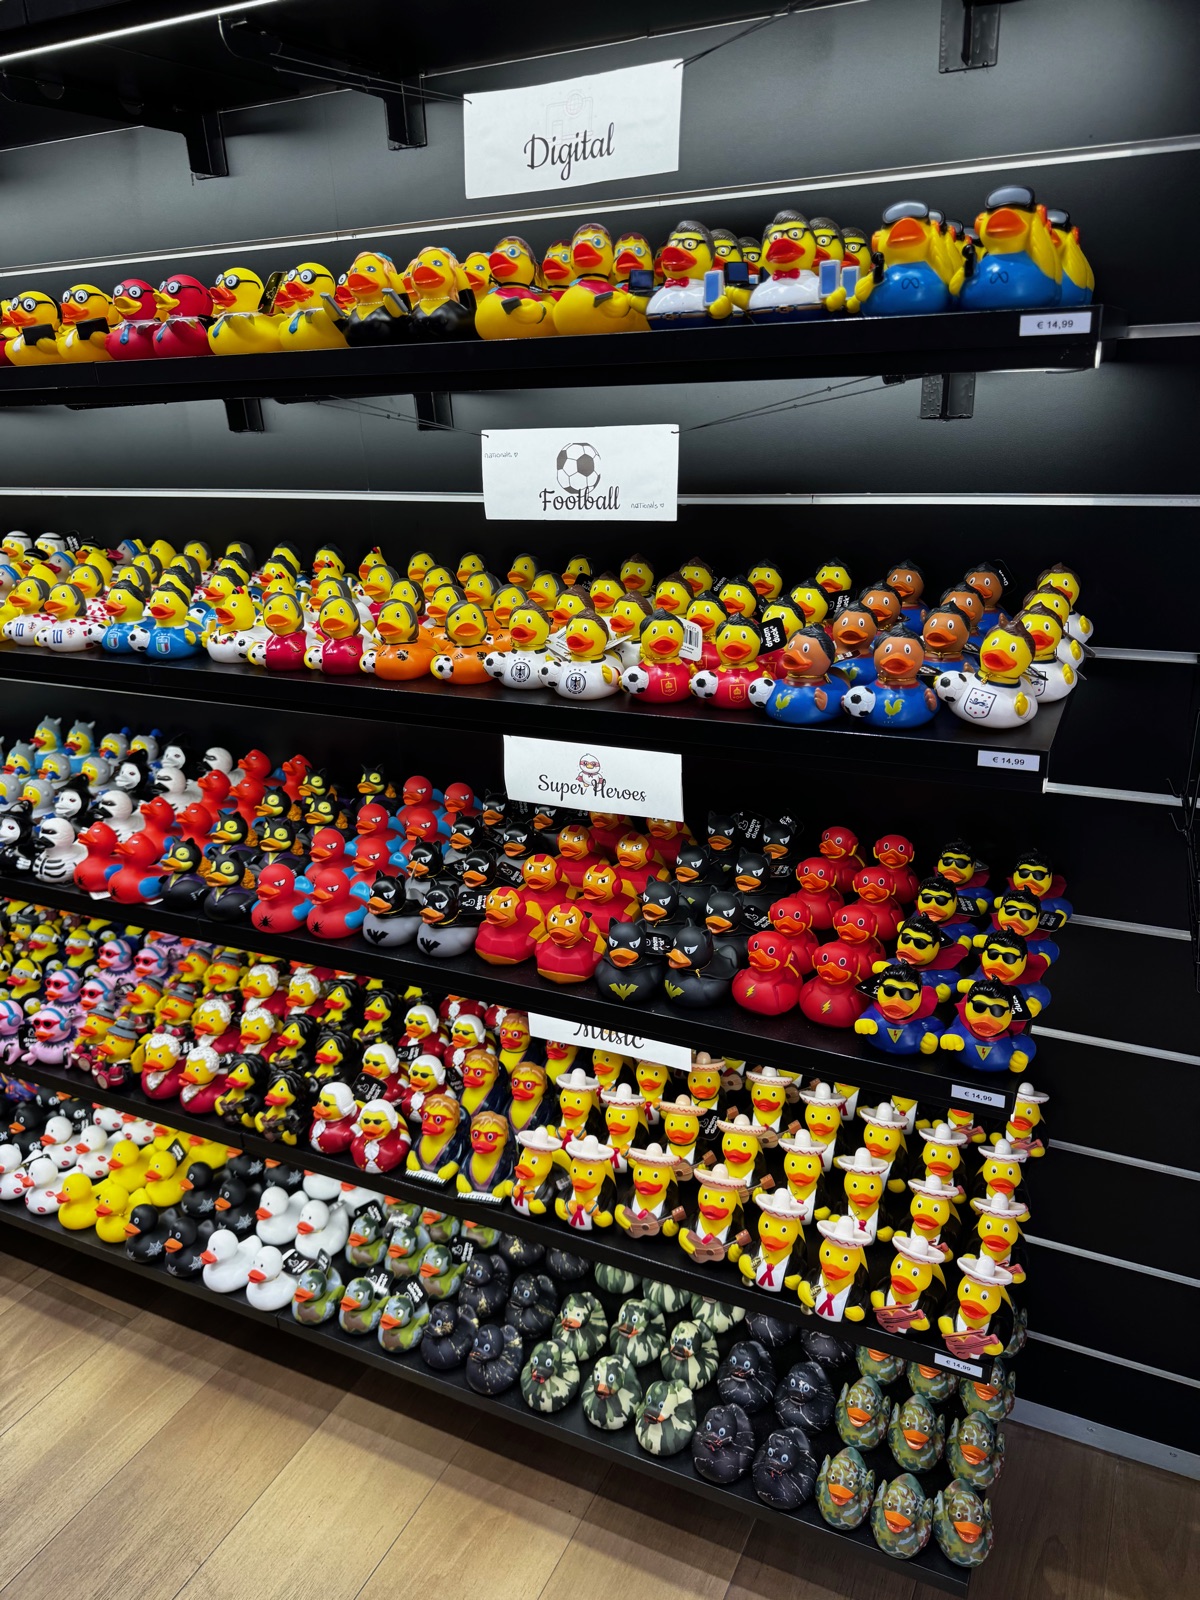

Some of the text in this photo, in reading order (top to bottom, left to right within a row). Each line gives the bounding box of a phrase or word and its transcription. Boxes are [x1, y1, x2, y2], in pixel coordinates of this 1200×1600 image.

[523, 121, 616, 181] Digital
[1036, 319, 1074, 330] € 14,99
[538, 485, 621, 512] Football
[763, 626, 774, 648] dream
[1001, 757, 1025, 766] 14,99
[537, 773, 647, 803] Super Heroes
[745, 818, 757, 839] dream
[972, 1092, 993, 1102] 14,99
[952, 1361, 972, 1372] 14,99
